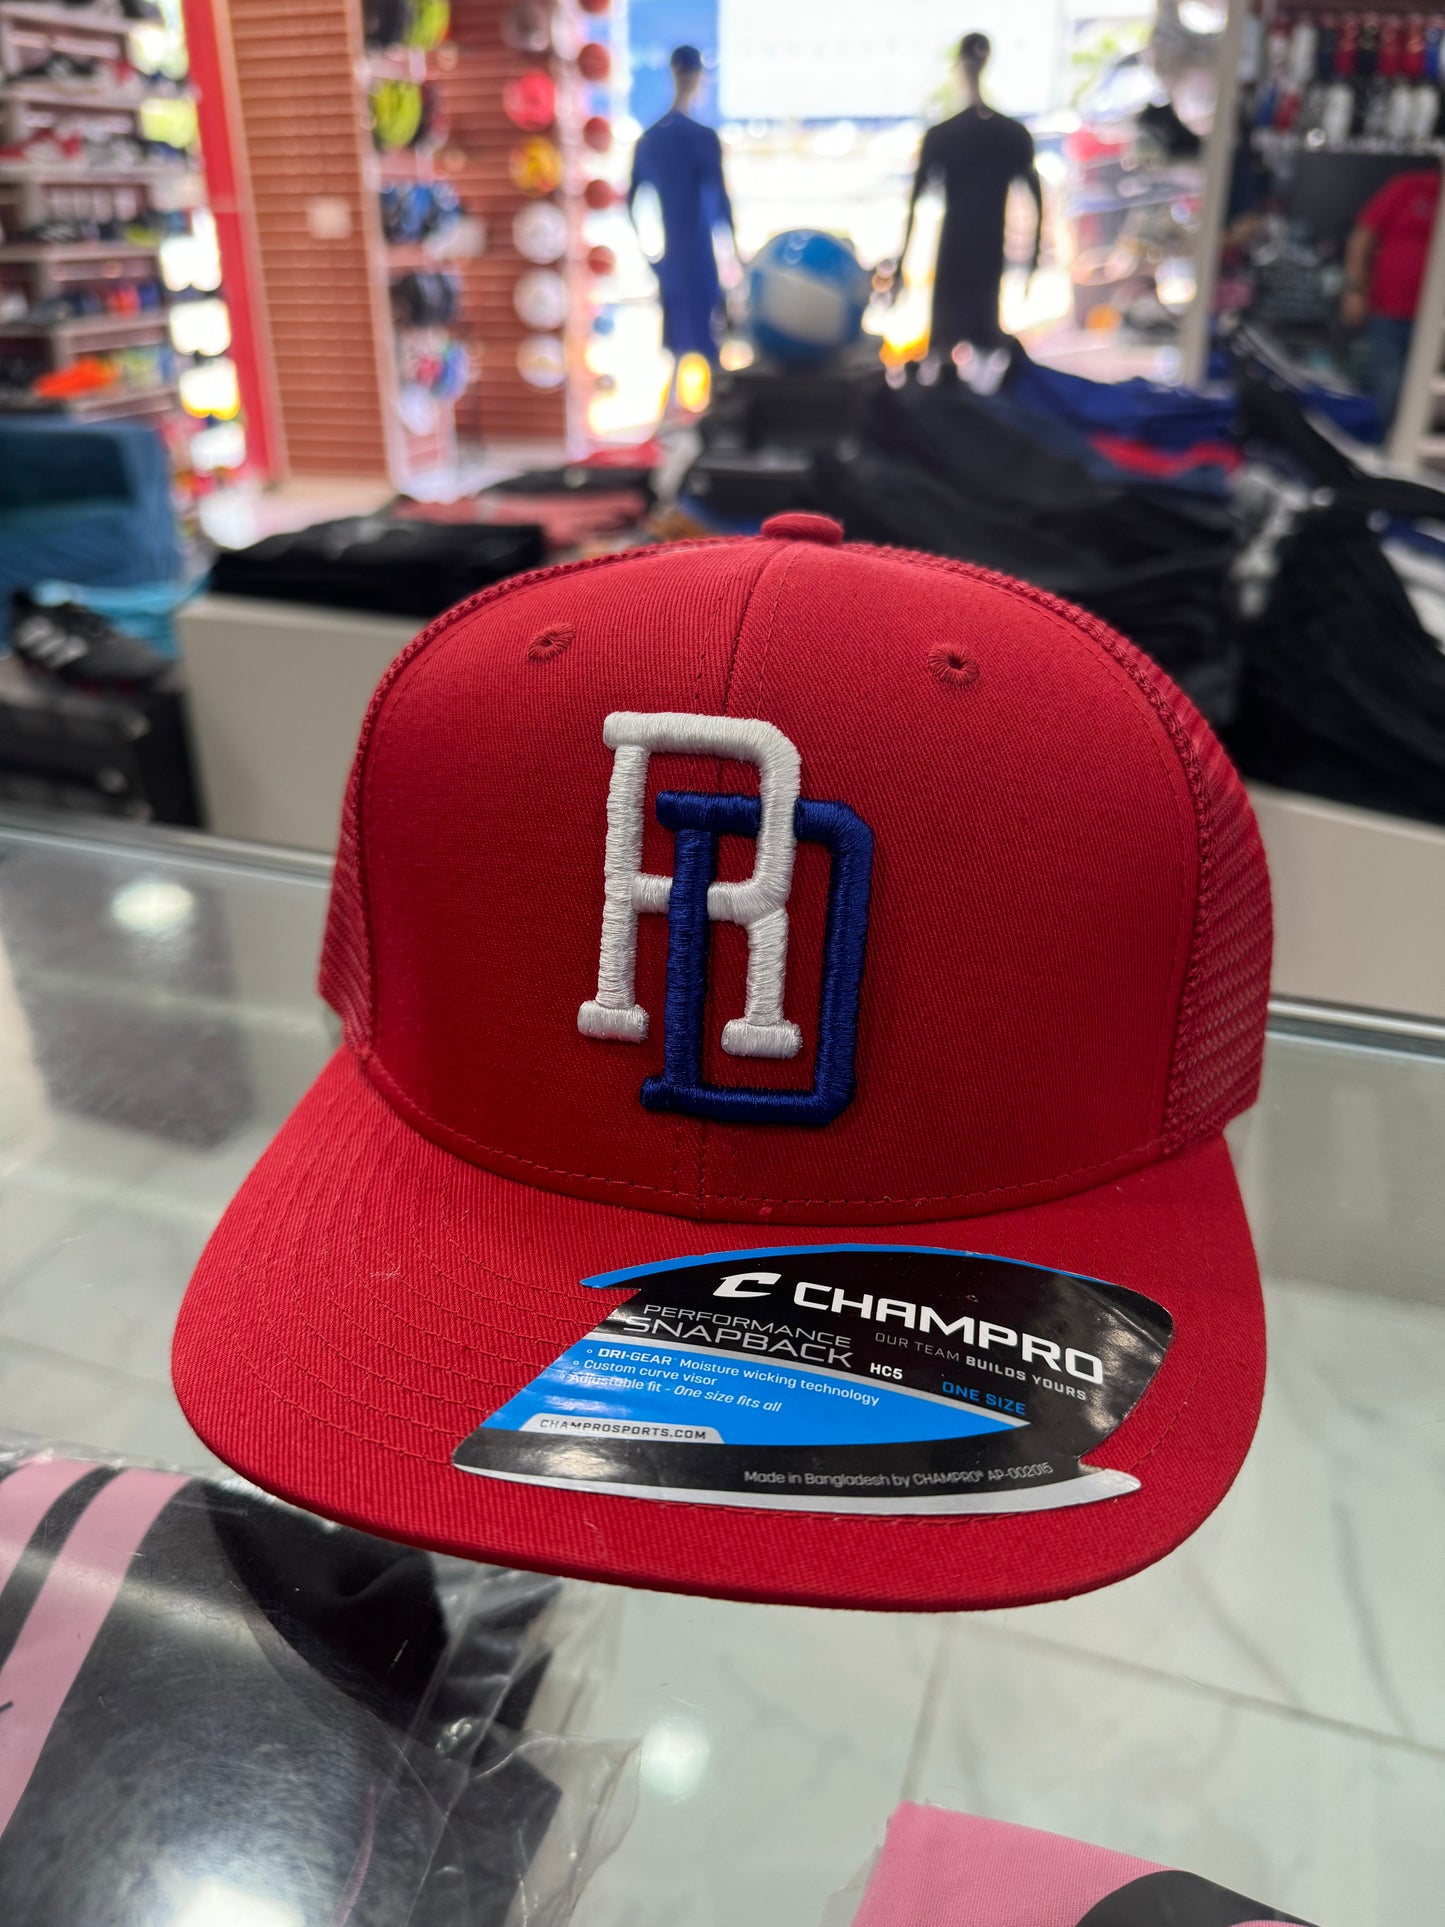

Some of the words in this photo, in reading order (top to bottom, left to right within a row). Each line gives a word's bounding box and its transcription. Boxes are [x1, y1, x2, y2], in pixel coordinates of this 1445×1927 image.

[623, 1315, 854, 1368] SNAPBACK
[643, 1304, 852, 1349] PERFORMANCE
[793, 1281, 1104, 1385] CHAMPRO
[584, 1359, 636, 1375] Custom
[639, 1367, 679, 1380] curve
[683, 1373, 718, 1386] visor
[679, 1358, 740, 1377] Moisture
[743, 1370, 797, 1389] wicking
[800, 1380, 880, 1407] technology
[869, 1362, 903, 1380] HC5
[875, 1332, 909, 1349] OUR
[915, 1341, 960, 1362] TEAM
[965, 1355, 1027, 1381] BUILDS
[1032, 1374, 1087, 1401] YOURS
[568, 1373, 644, 1390] Adjustable
[647, 1382, 662, 1392] fit
[674, 1385, 702, 1398] One
[704, 1390, 734, 1404] size
[736, 1395, 760, 1409] fits
[762, 1401, 782, 1413] all
[942, 1381, 980, 1402] ONE
[986, 1393, 1027, 1416] SIZE
[540, 1418, 707, 1440] CHAMPROSPORTS.COM
[744, 1471, 786, 1483] Made
[788, 1472, 801, 1484] in
[804, 1473, 890, 1488] Bangladesh
[891, 1474, 910, 1488] by
